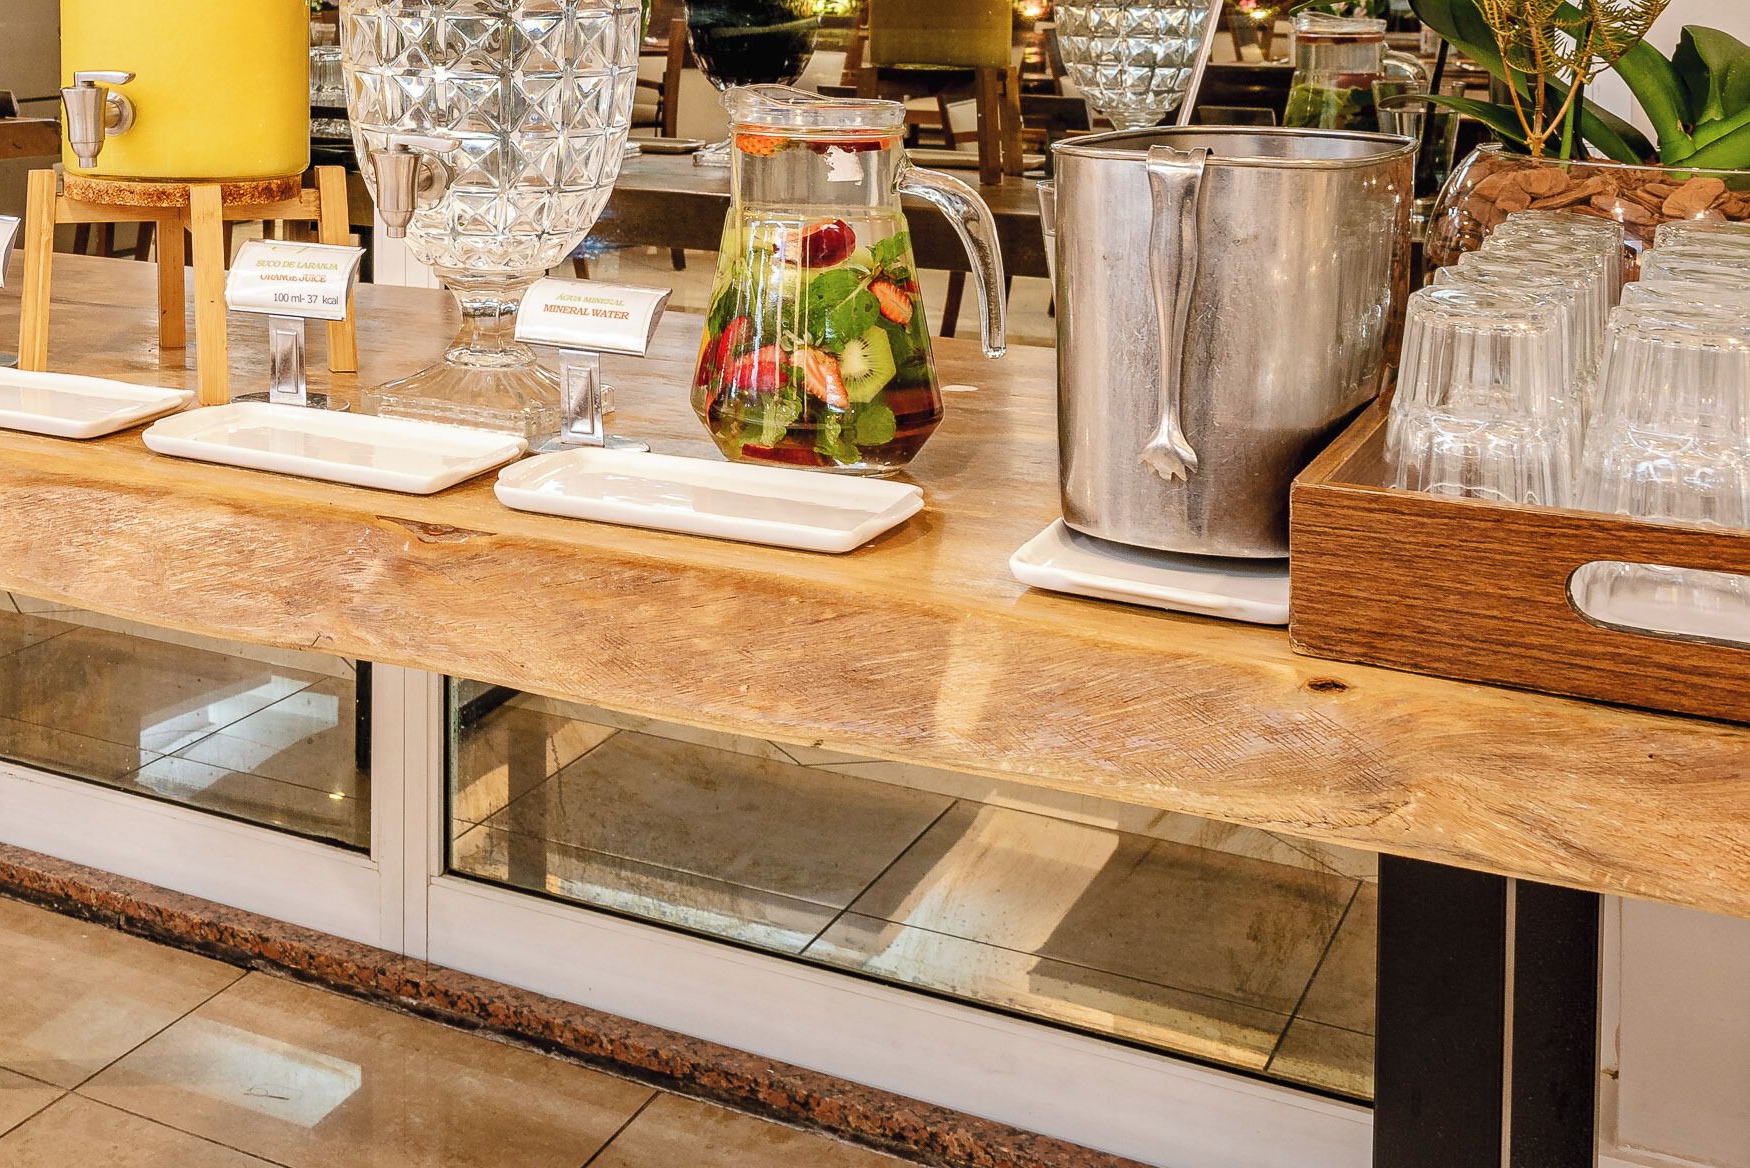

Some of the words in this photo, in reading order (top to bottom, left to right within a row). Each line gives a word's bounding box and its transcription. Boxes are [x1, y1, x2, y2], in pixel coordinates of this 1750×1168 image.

[256, 260, 281, 268] SUCO
[282, 261, 296, 269] DE
[296, 262, 338, 271] LARANJA
[299, 274, 326, 282] JUICE
[274, 293, 289, 303] 100
[307, 294, 318, 304] 37
[322, 295, 339, 305] kcal
[544, 304, 589, 316] MINERAL
[592, 309, 629, 319] WATER
